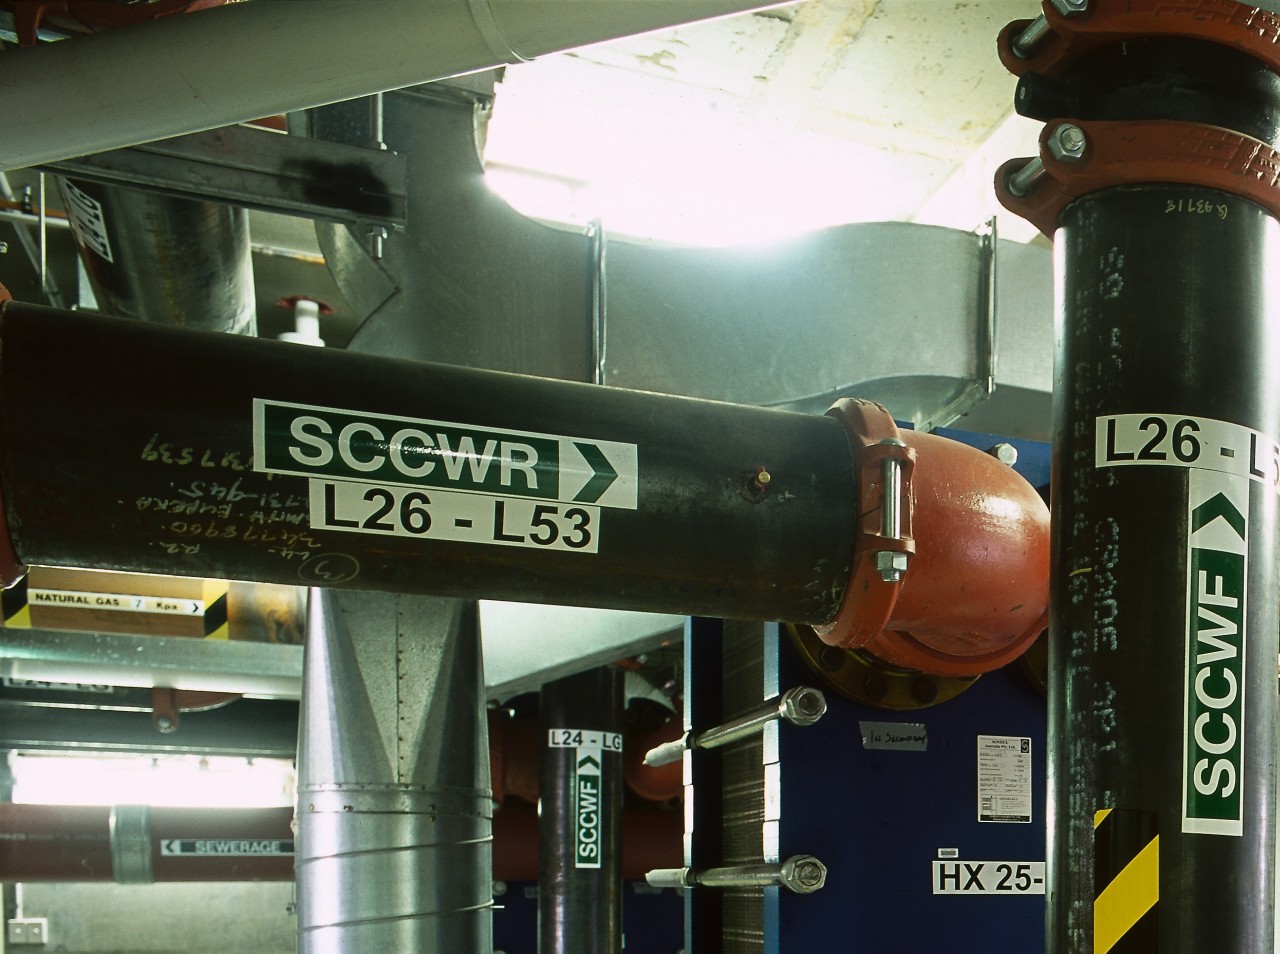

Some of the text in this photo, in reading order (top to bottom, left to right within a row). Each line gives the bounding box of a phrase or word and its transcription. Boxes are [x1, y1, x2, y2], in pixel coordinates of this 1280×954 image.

[288, 415, 543, 490] SCCWR
[1106, 416, 1201, 463] L26
[323, 484, 433, 535] L26
[493, 499, 593, 550] L53
[35, 593, 90, 605] NATURAL
[96, 597, 120, 606] GAS
[156, 602, 178, 611] Kpa
[1193, 568, 1240, 799] SCCWF
[551, 730, 583, 746] L24
[602, 733, 621, 750] LG
[577, 780, 600, 860] SCCWF
[195, 841, 280, 853] SEWERAGE
[939, 863, 1043, 891] HX 25-
